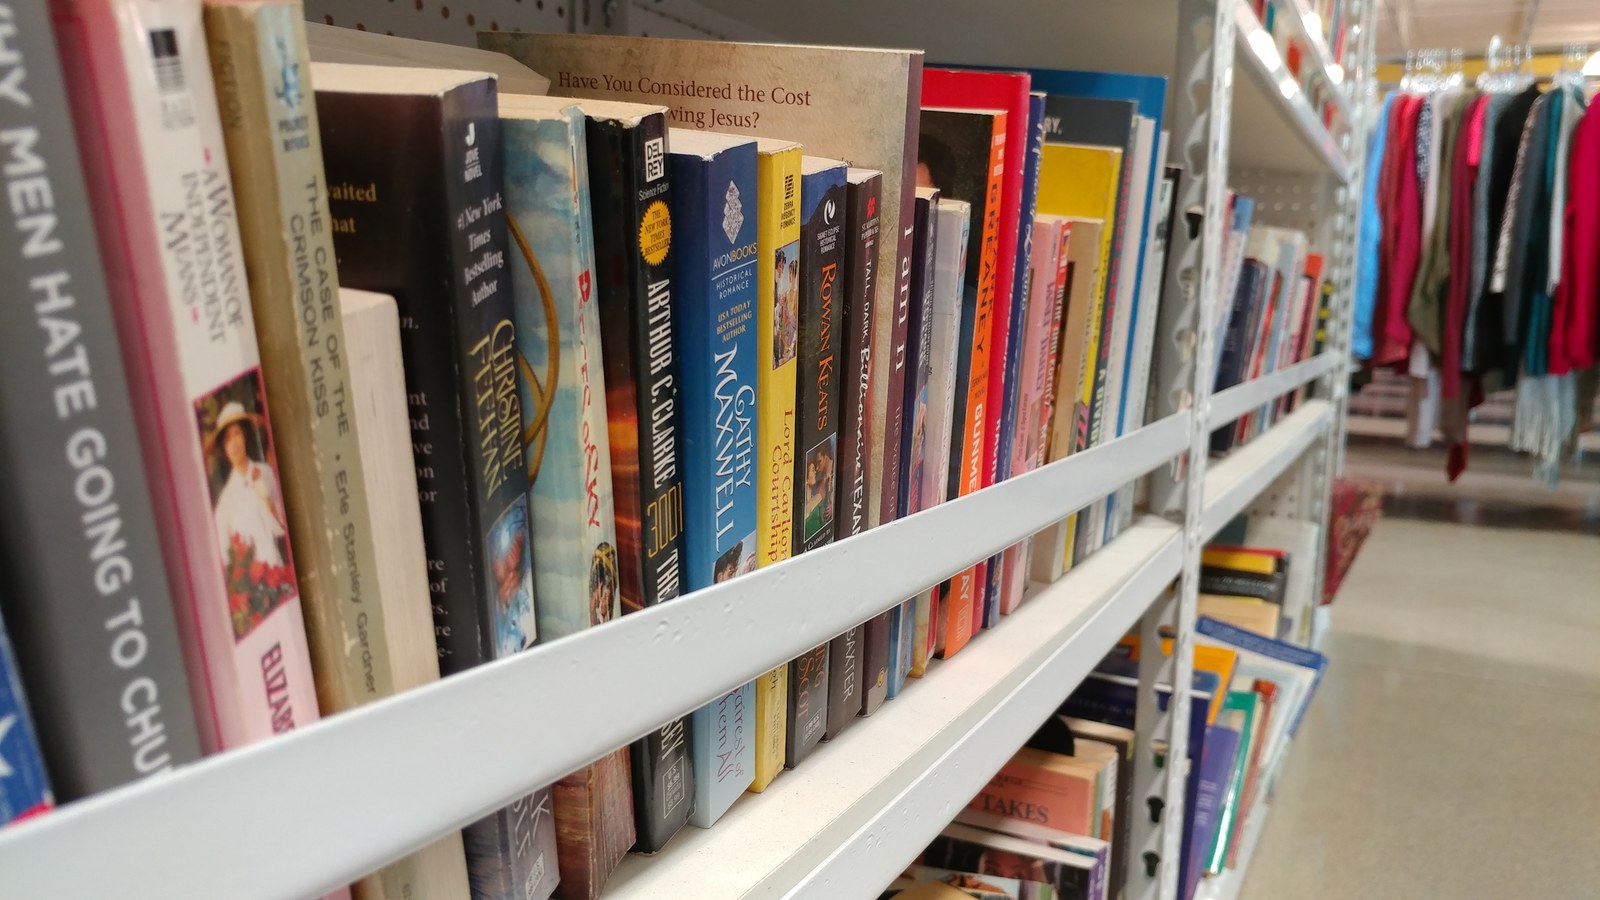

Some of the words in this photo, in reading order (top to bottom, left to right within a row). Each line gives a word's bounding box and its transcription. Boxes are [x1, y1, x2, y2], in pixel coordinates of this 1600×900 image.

[0, 2, 33, 108] HY
[558, 71, 599, 90] Have
[602, 74, 633, 93] You
[637, 76, 732, 100] Considered
[737, 84, 767, 103] the
[771, 87, 812, 107] Cost
[708, 108, 761, 129] Jesus?
[646, 142, 663, 161] DEL
[647, 158, 663, 178] REY
[1, 126, 64, 259] MEN
[305, 174, 323, 236] THE
[330, 182, 377, 202] aited
[481, 191, 503, 218] York
[638, 186, 657, 202] Science
[207, 184, 240, 296] WOMAN
[224, 296, 245, 328] OF
[463, 250, 504, 287] Bestselling
[467, 228, 492, 253] Times
[313, 245, 336, 324] CASE
[470, 278, 499, 308] Author
[715, 268, 753, 290] HISTORICAL
[717, 308, 730, 323] USA
[730, 299, 752, 317] TODAY
[719, 281, 750, 301] ROMANCE
[820, 259, 837, 351] ROWAN
[864, 258, 873, 298] TALL,
[29, 271, 98, 419] HATE
[290, 213, 320, 348] CRIMSON
[310, 356, 330, 420] KISS
[648, 278, 672, 375] ARTHUR
[716, 310, 753, 335] BESTSELLING
[721, 324, 747, 344] AUTHOR
[861, 301, 871, 344] DARK,
[326, 333, 341, 372] OF
[332, 382, 351, 438] THE
[467, 334, 509, 500] FEEHAN
[491, 318, 523, 472] CHRISTINE
[816, 353, 834, 432] KEATS
[854, 344, 871, 472] Billionaire
[652, 398, 676, 490] CLARKE
[713, 341, 738, 553] MAXWELL
[734, 383, 757, 489] CATHY
[783, 410, 793, 465] Lord
[66, 428, 134, 594] GOING
[646, 481, 684, 559] 3001
[767, 444, 783, 562] Courtship
[343, 521, 364, 605] Stanley
[656, 548, 680, 604] THE
[105, 598, 148, 669] TO
[356, 610, 378, 695] Gardner
[121, 677, 177, 776] CHU
[718, 690, 734, 750] hem
[734, 683, 747, 758] airest
